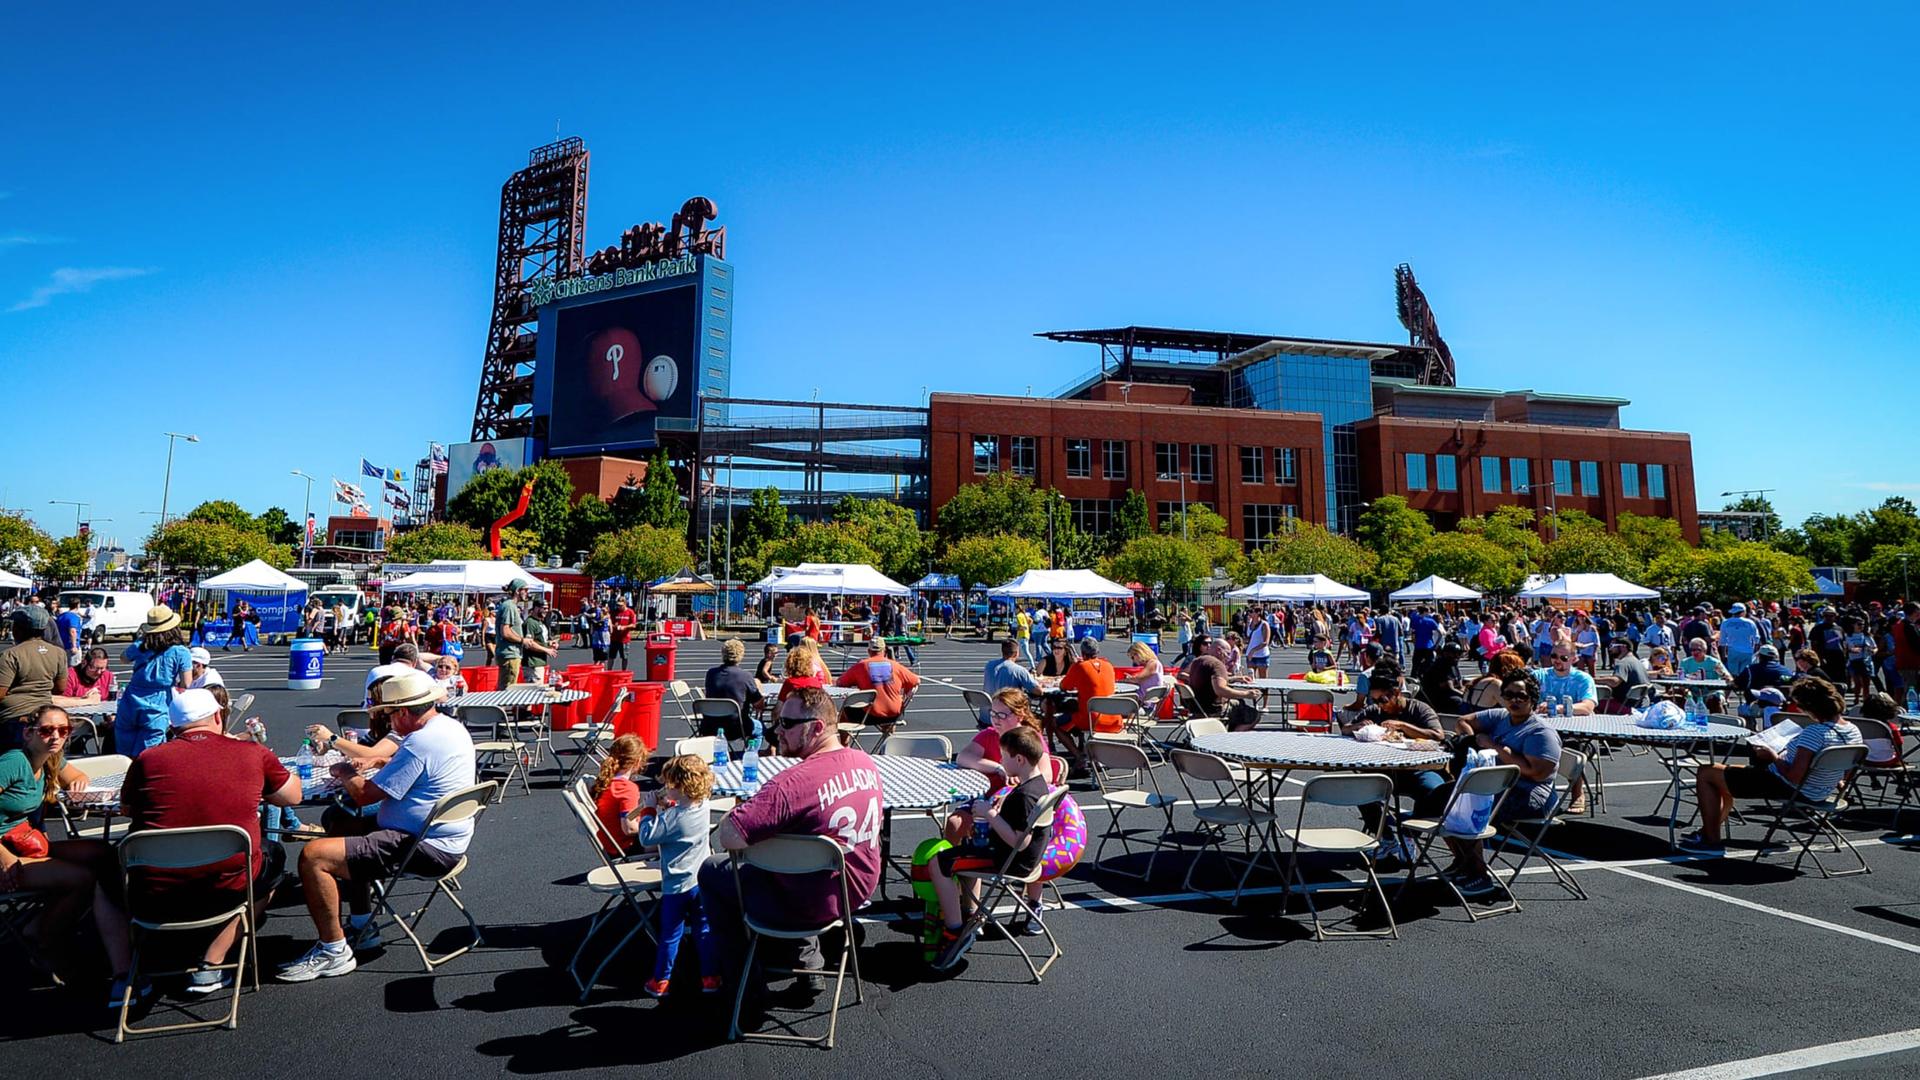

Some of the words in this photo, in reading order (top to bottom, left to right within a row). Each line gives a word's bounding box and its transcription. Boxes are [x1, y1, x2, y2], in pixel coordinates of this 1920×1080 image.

[555, 274, 614, 299] Citizens
[615, 262, 656, 287] Bank
[659, 253, 697, 277] Park
[829, 797, 879, 853] 34
